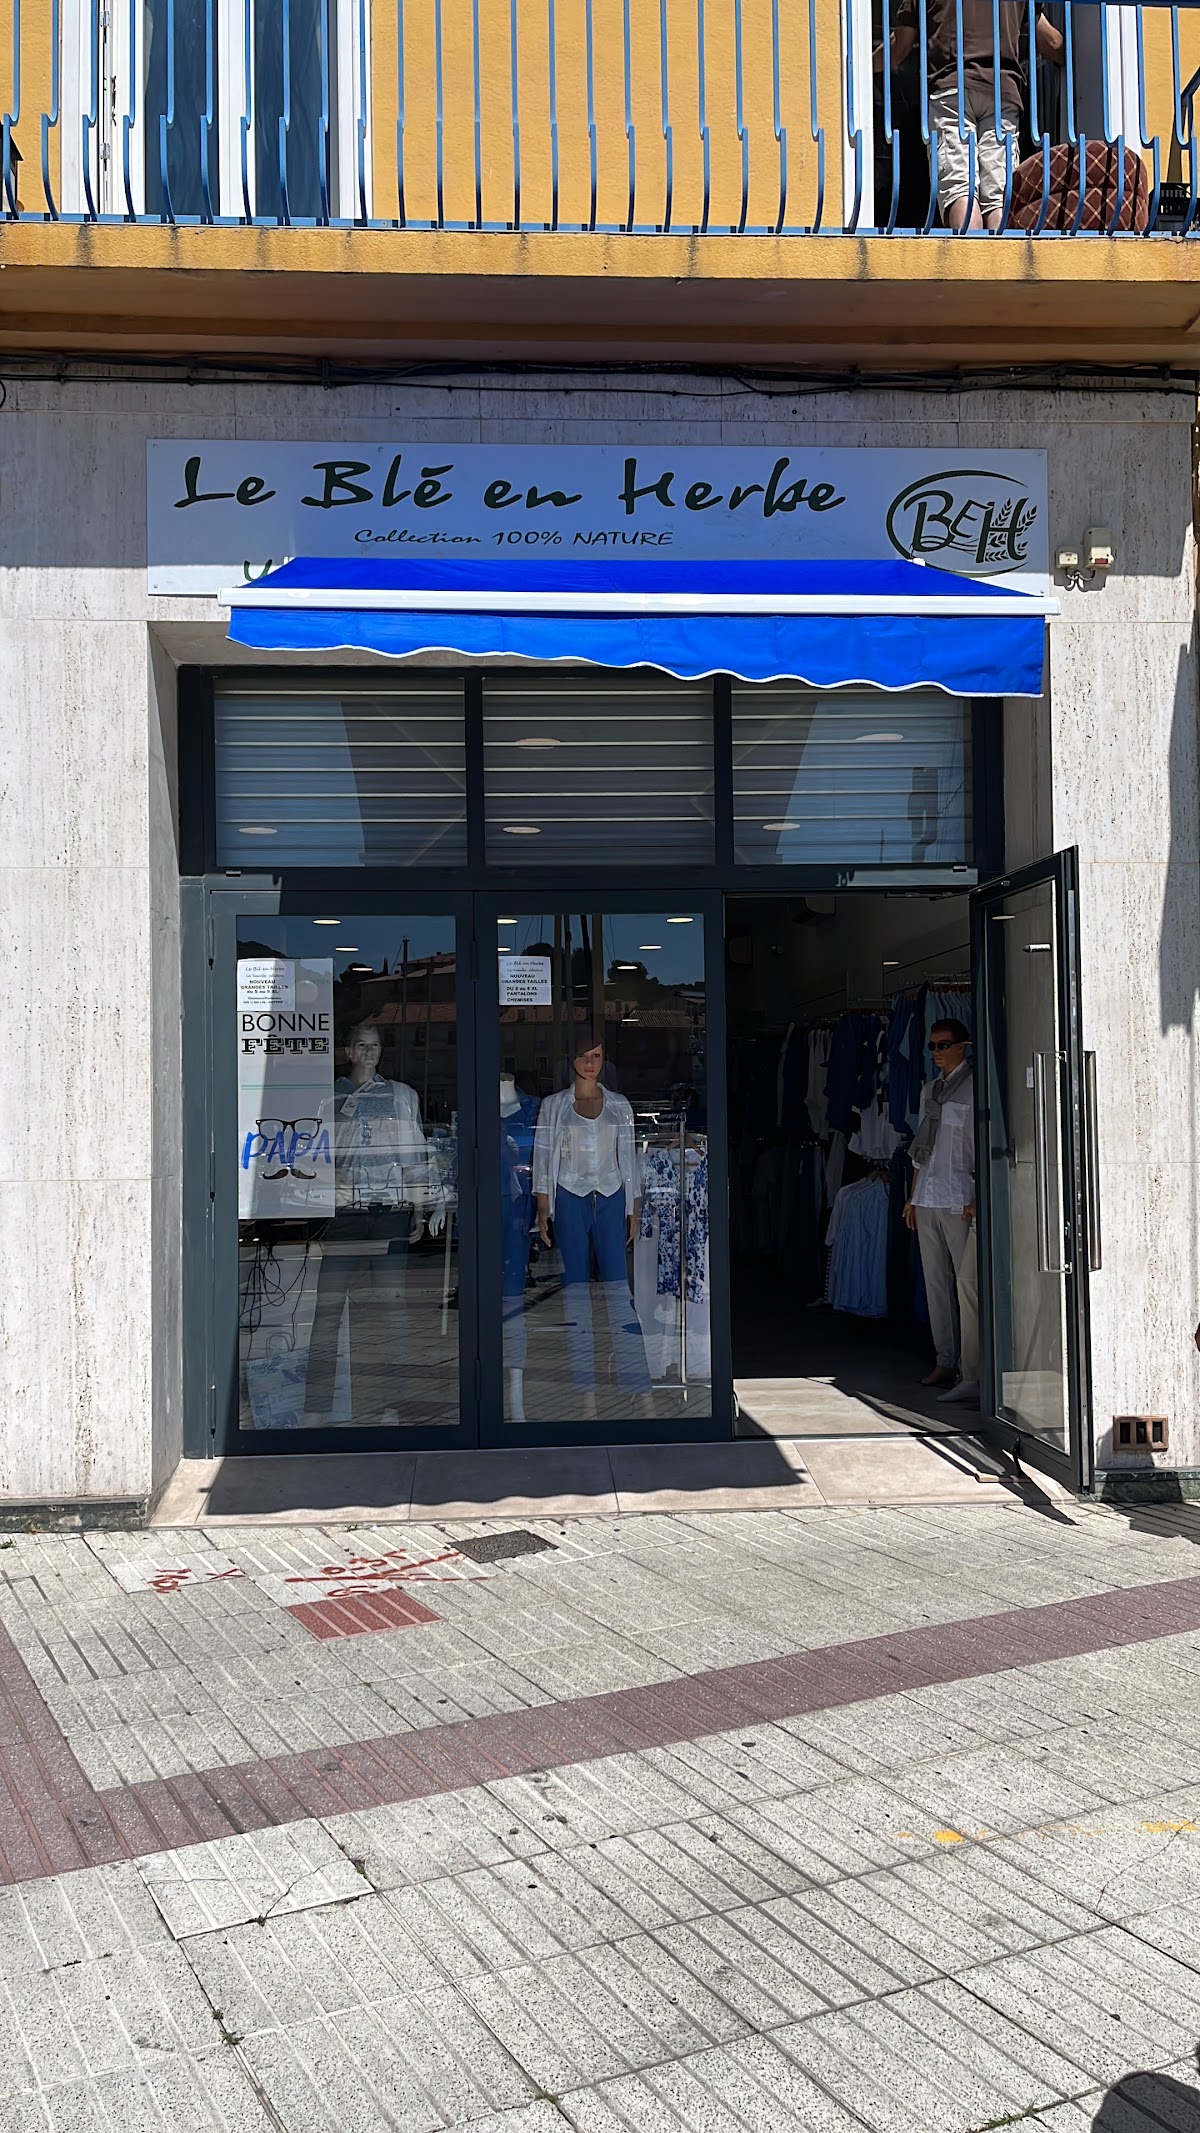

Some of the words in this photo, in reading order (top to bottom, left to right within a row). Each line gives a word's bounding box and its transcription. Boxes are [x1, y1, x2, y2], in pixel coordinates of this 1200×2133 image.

[173, 456, 277, 509] Le
[301, 454, 455, 510] Blé
[483, 478, 583, 510] en
[617, 456, 847, 518] Herbe
[354, 528, 482, 545] Collection
[490, 529, 563, 546] 100%
[572, 530, 675, 546] NATURE
[904, 489, 1031, 564] BEH
[242, 1013, 329, 1032] BONNE
[241, 1034, 330, 1055] FÊTE
[241, 1129, 332, 1170] PAPA
